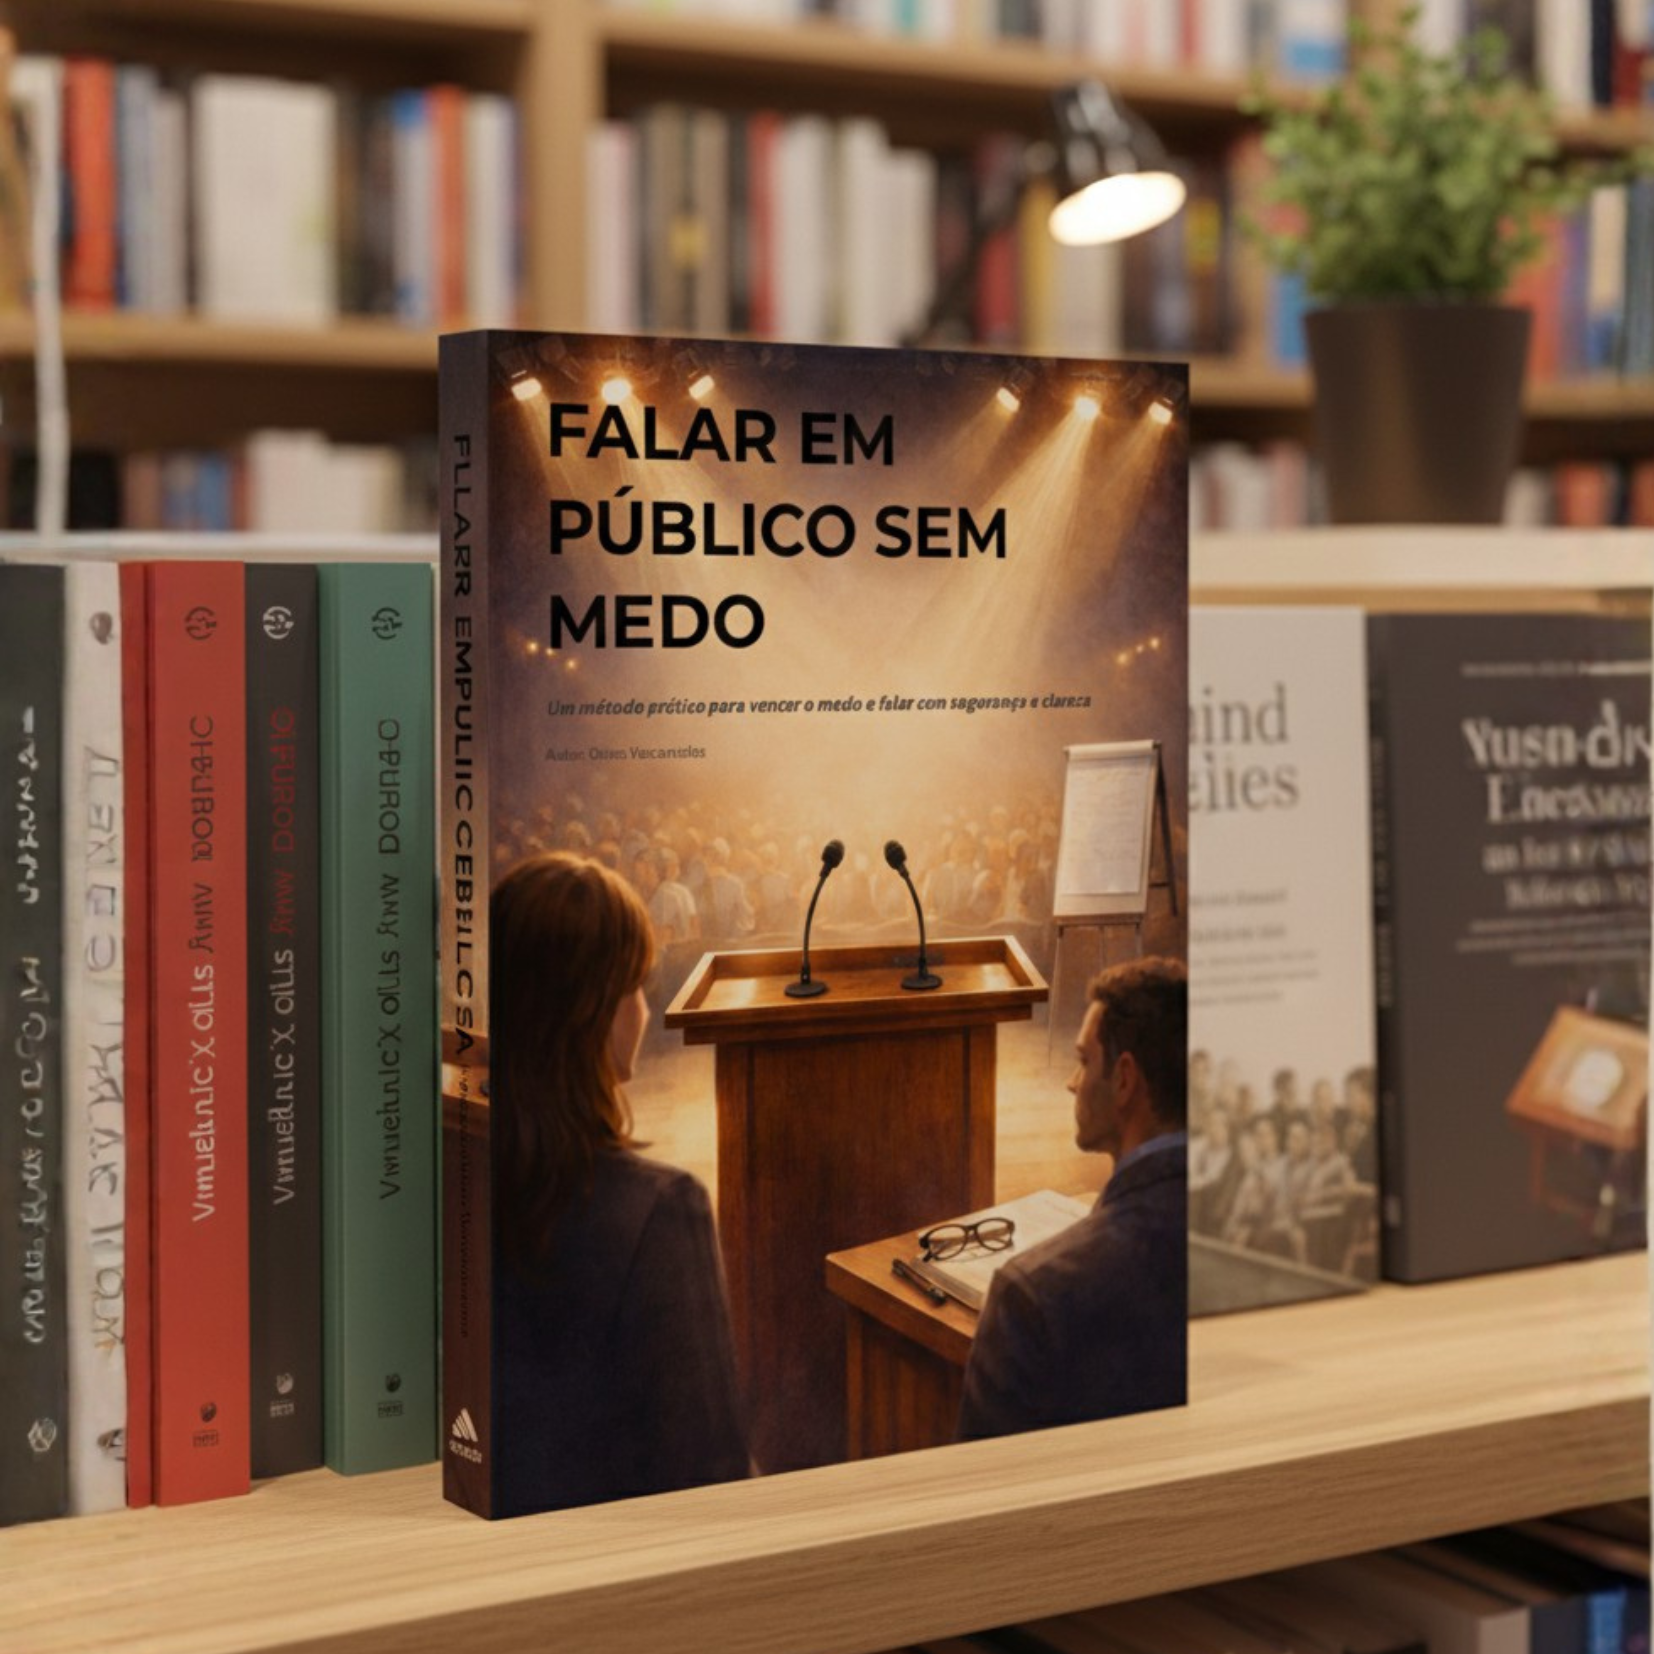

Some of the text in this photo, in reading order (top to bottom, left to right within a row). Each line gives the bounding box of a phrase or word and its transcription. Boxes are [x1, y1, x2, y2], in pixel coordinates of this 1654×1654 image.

[549, 402, 894, 467] FALAR EM
[454, 434, 472, 598] FLLARR
[549, 485, 1007, 558] PÚBLICO SEM
[549, 594, 765, 649] MEDO
[547, 700, 575, 715] Um
[579, 698, 644, 716] método
[707, 700, 746, 717] para
[750, 699, 802, 713] vencer
[803, 699, 815, 713] o
[817, 695, 863, 713] medo
[865, 698, 876, 712] e
